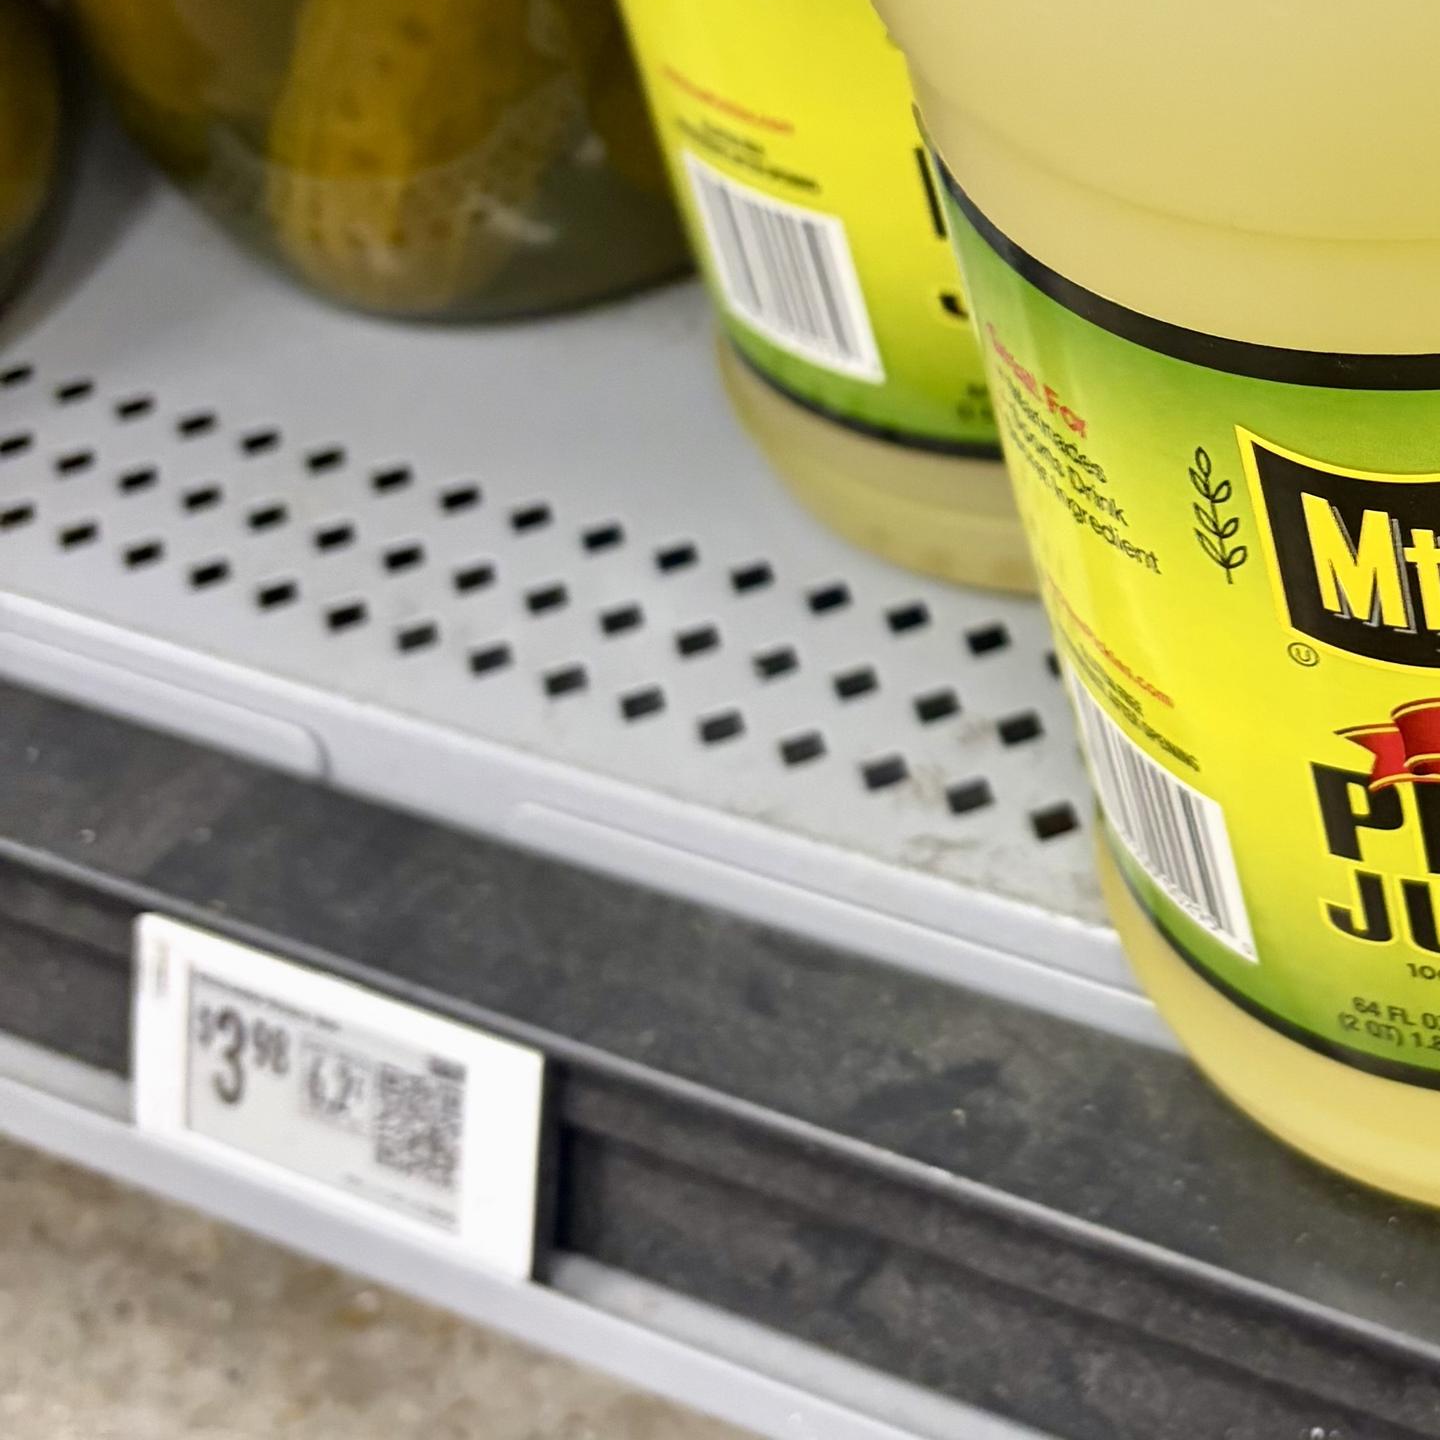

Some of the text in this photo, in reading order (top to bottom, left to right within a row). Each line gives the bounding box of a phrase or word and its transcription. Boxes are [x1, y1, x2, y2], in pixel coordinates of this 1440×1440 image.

[1066, 463, 1130, 528] Drink
[1352, 996, 1382, 1014] 64
[1387, 1004, 1416, 1028] FL
